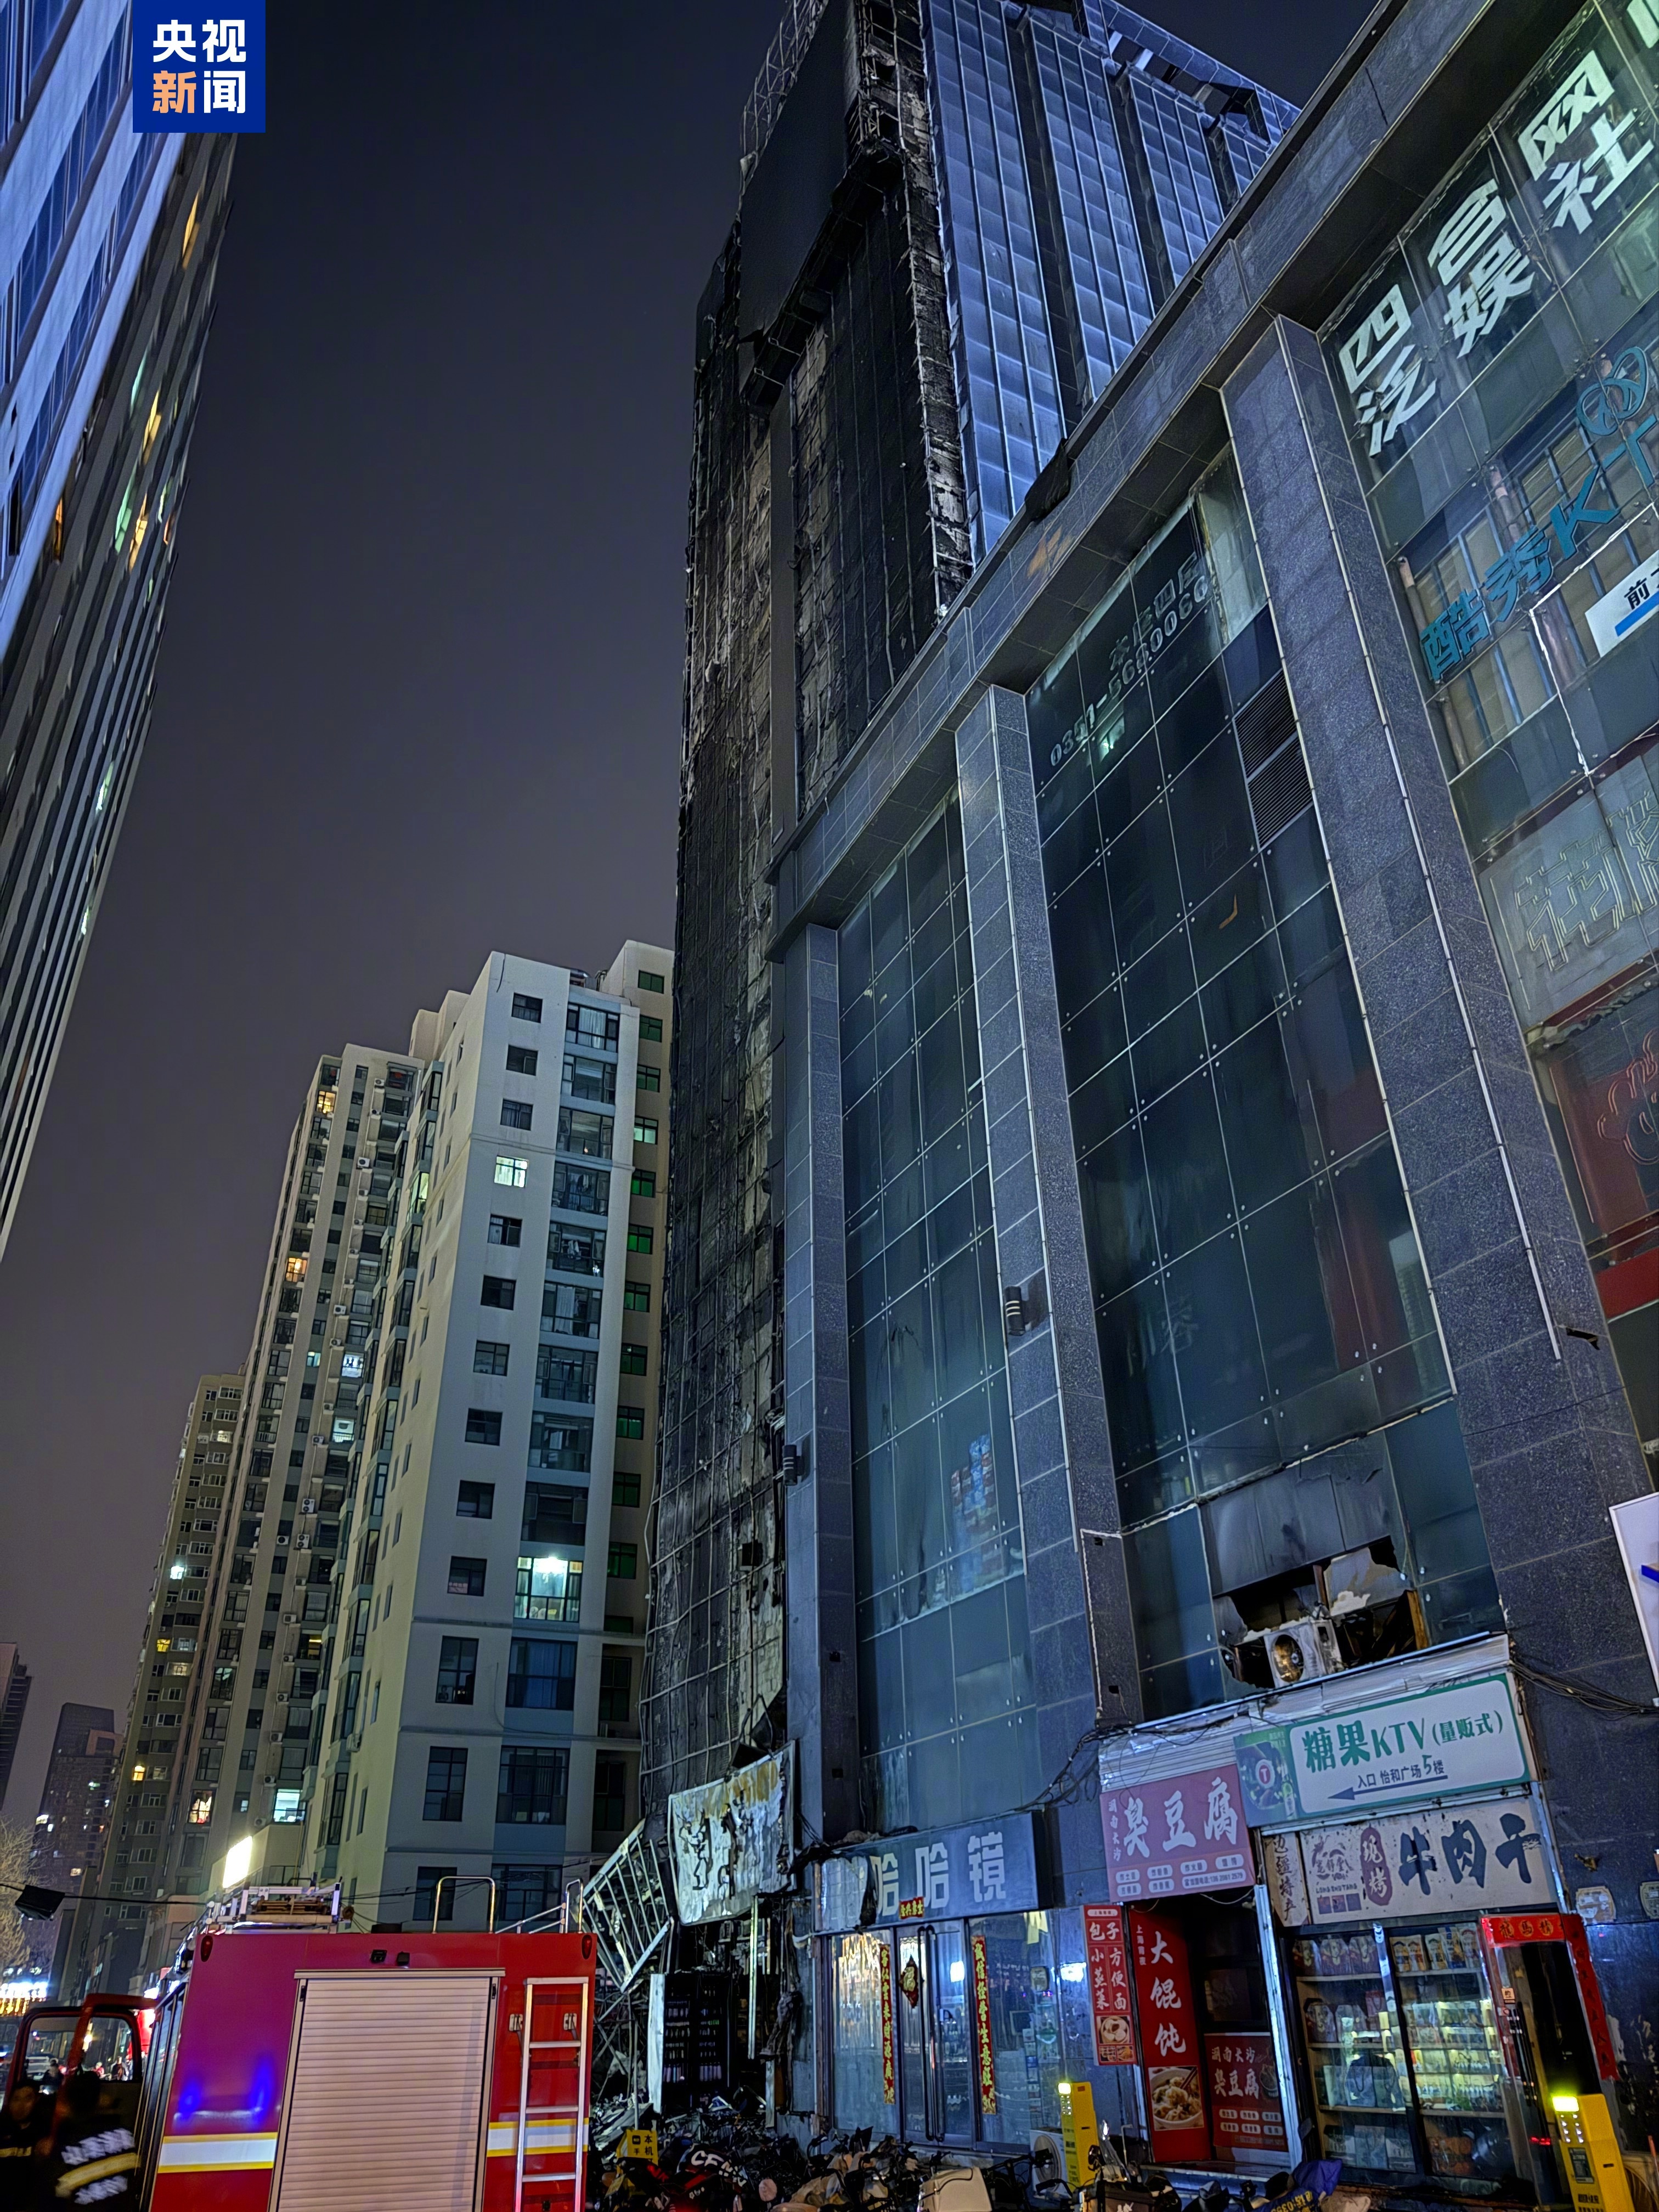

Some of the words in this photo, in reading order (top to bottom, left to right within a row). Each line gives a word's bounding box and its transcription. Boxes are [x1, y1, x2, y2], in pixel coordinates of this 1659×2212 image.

[1339, 0, 1659, 394] 四合网
[1624, 568, 1659, 610] 前
[1123, 1776, 1238, 1858] 臭豆腐
[1398, 1813, 1541, 1896] 牛肉干
[869, 1831, 1007, 1916] 哈哈镜
[1089, 1921, 1120, 1940] 包子
[1109, 1947, 1127, 2010] 方便面
[1150, 1931, 1186, 2057] 大馄饨
